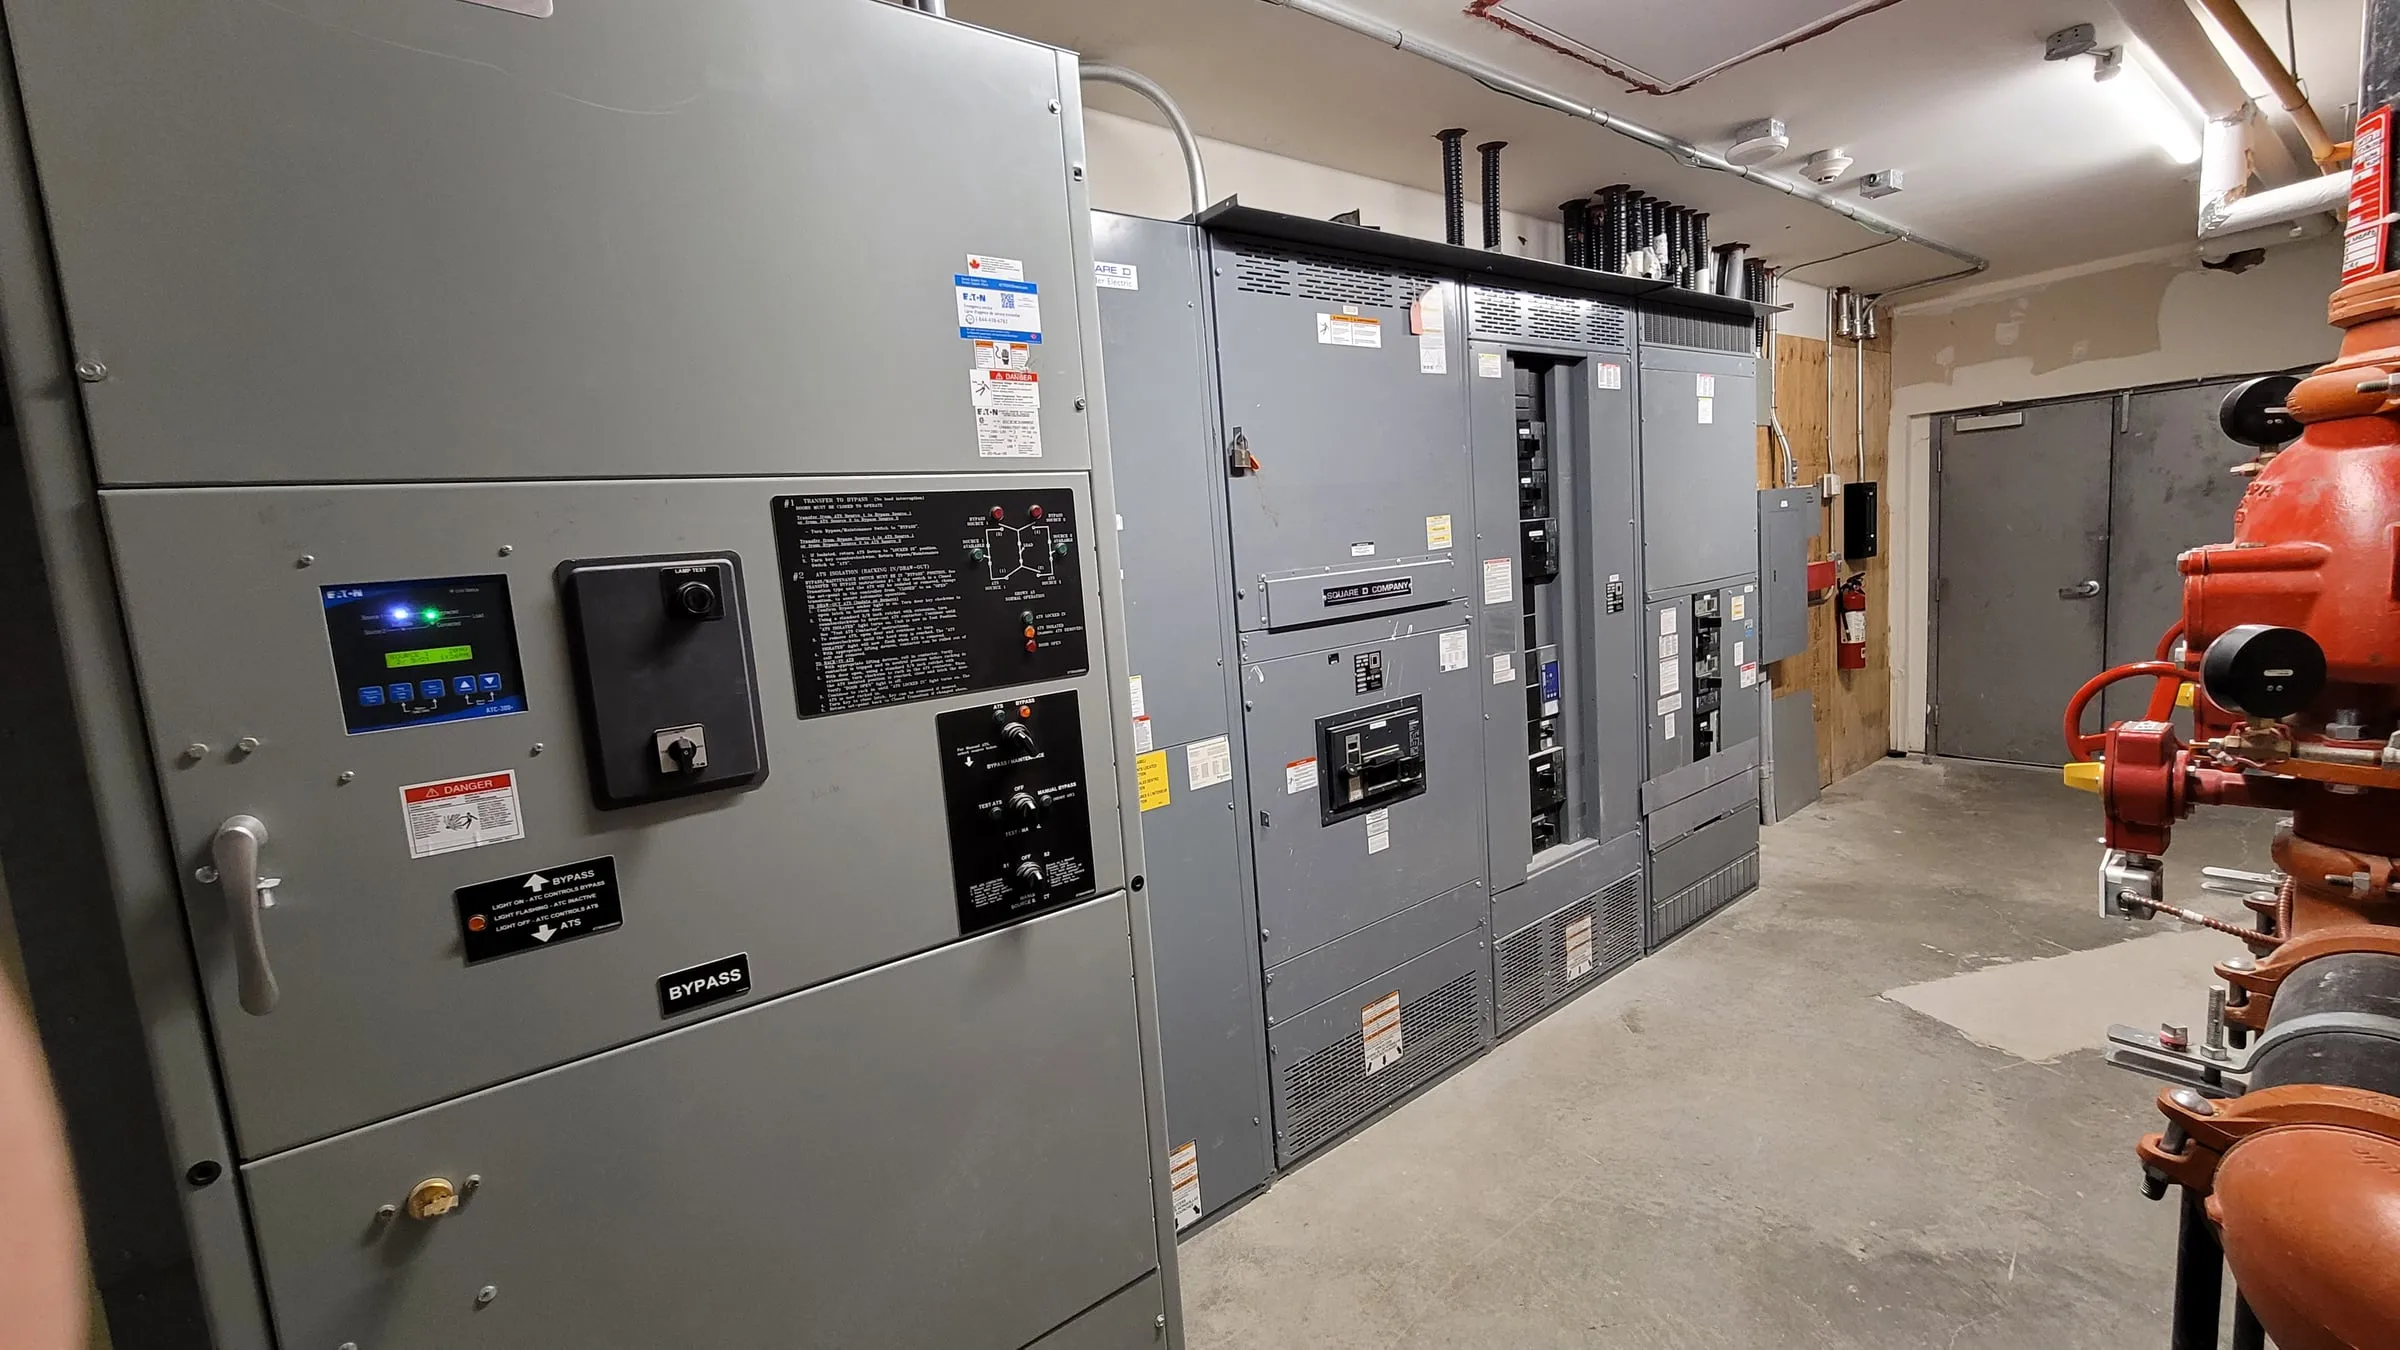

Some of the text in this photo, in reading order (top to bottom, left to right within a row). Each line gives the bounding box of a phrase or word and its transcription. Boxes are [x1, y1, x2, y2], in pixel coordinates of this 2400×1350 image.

[1095, 265, 1117, 274] ARE
[784, 499, 794, 508] #1
[793, 572, 804, 581] #2
[1327, 589, 1358, 599] SQUARE
[1372, 582, 1408, 593] COMPANY
[986, 760, 1008, 769] BYPASS
[444, 780, 493, 794] DANGER
[1037, 782, 1076, 795] MANUAL BYPASS
[552, 869, 594, 885] BYPASS
[491, 901, 512, 910] LIGHT
[543, 886, 578, 898] CONTROLS
[579, 880, 605, 890] BYPASS
[493, 912, 514, 921] LIGHT
[515, 904, 548, 916] FLASHING
[567, 892, 596, 904] INACTIVE
[495, 922, 516, 932] LIGHT
[550, 906, 585, 918] CONTROLS
[559, 918, 581, 929] ATS
[668, 968, 742, 1001] BYPASS
